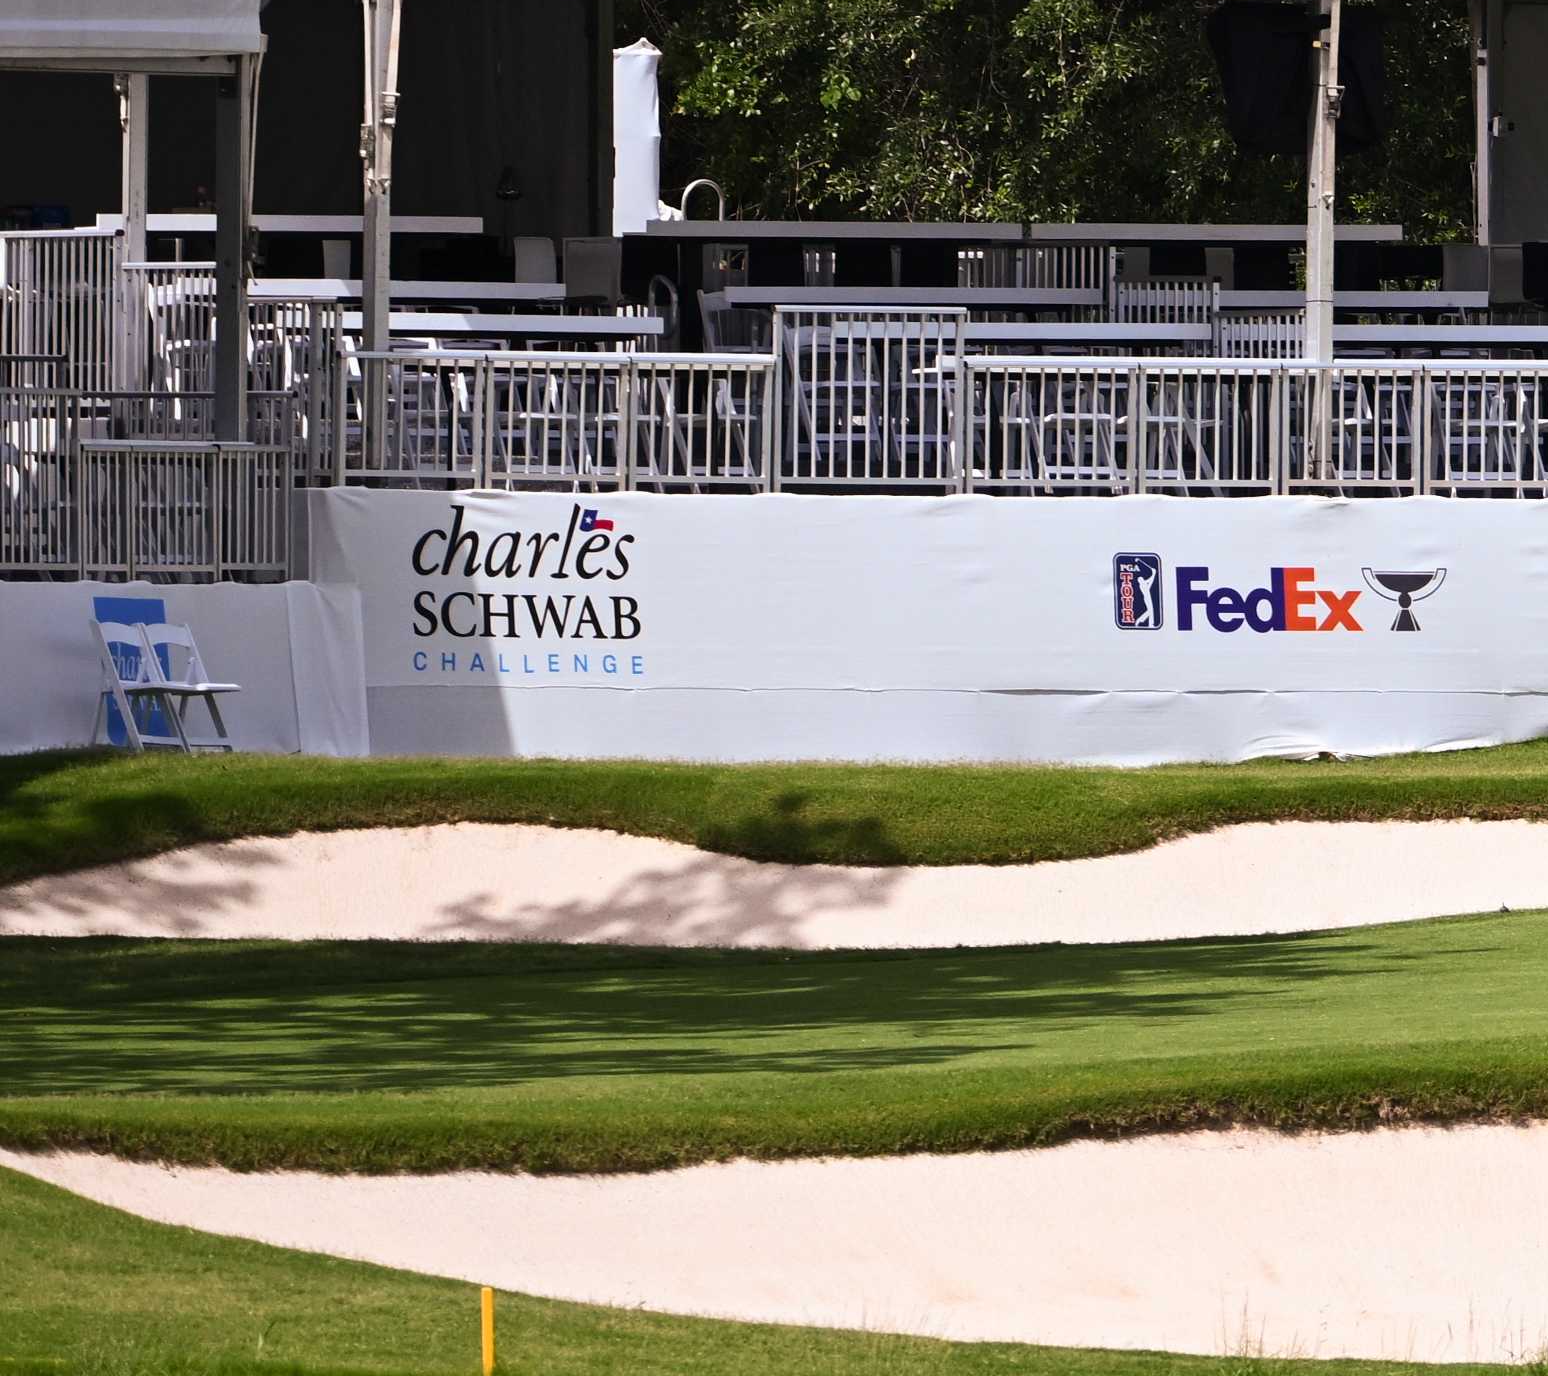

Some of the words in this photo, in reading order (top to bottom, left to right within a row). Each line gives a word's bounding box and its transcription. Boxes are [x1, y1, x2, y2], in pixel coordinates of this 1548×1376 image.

[412, 503, 635, 580] charles
[1120, 564, 1140, 572] PGA
[413, 591, 641, 640] SCHWAB
[1120, 572, 1136, 624] TOUR
[1175, 566, 1364, 633] FedEx
[413, 652, 644, 674] CHALLENGE
